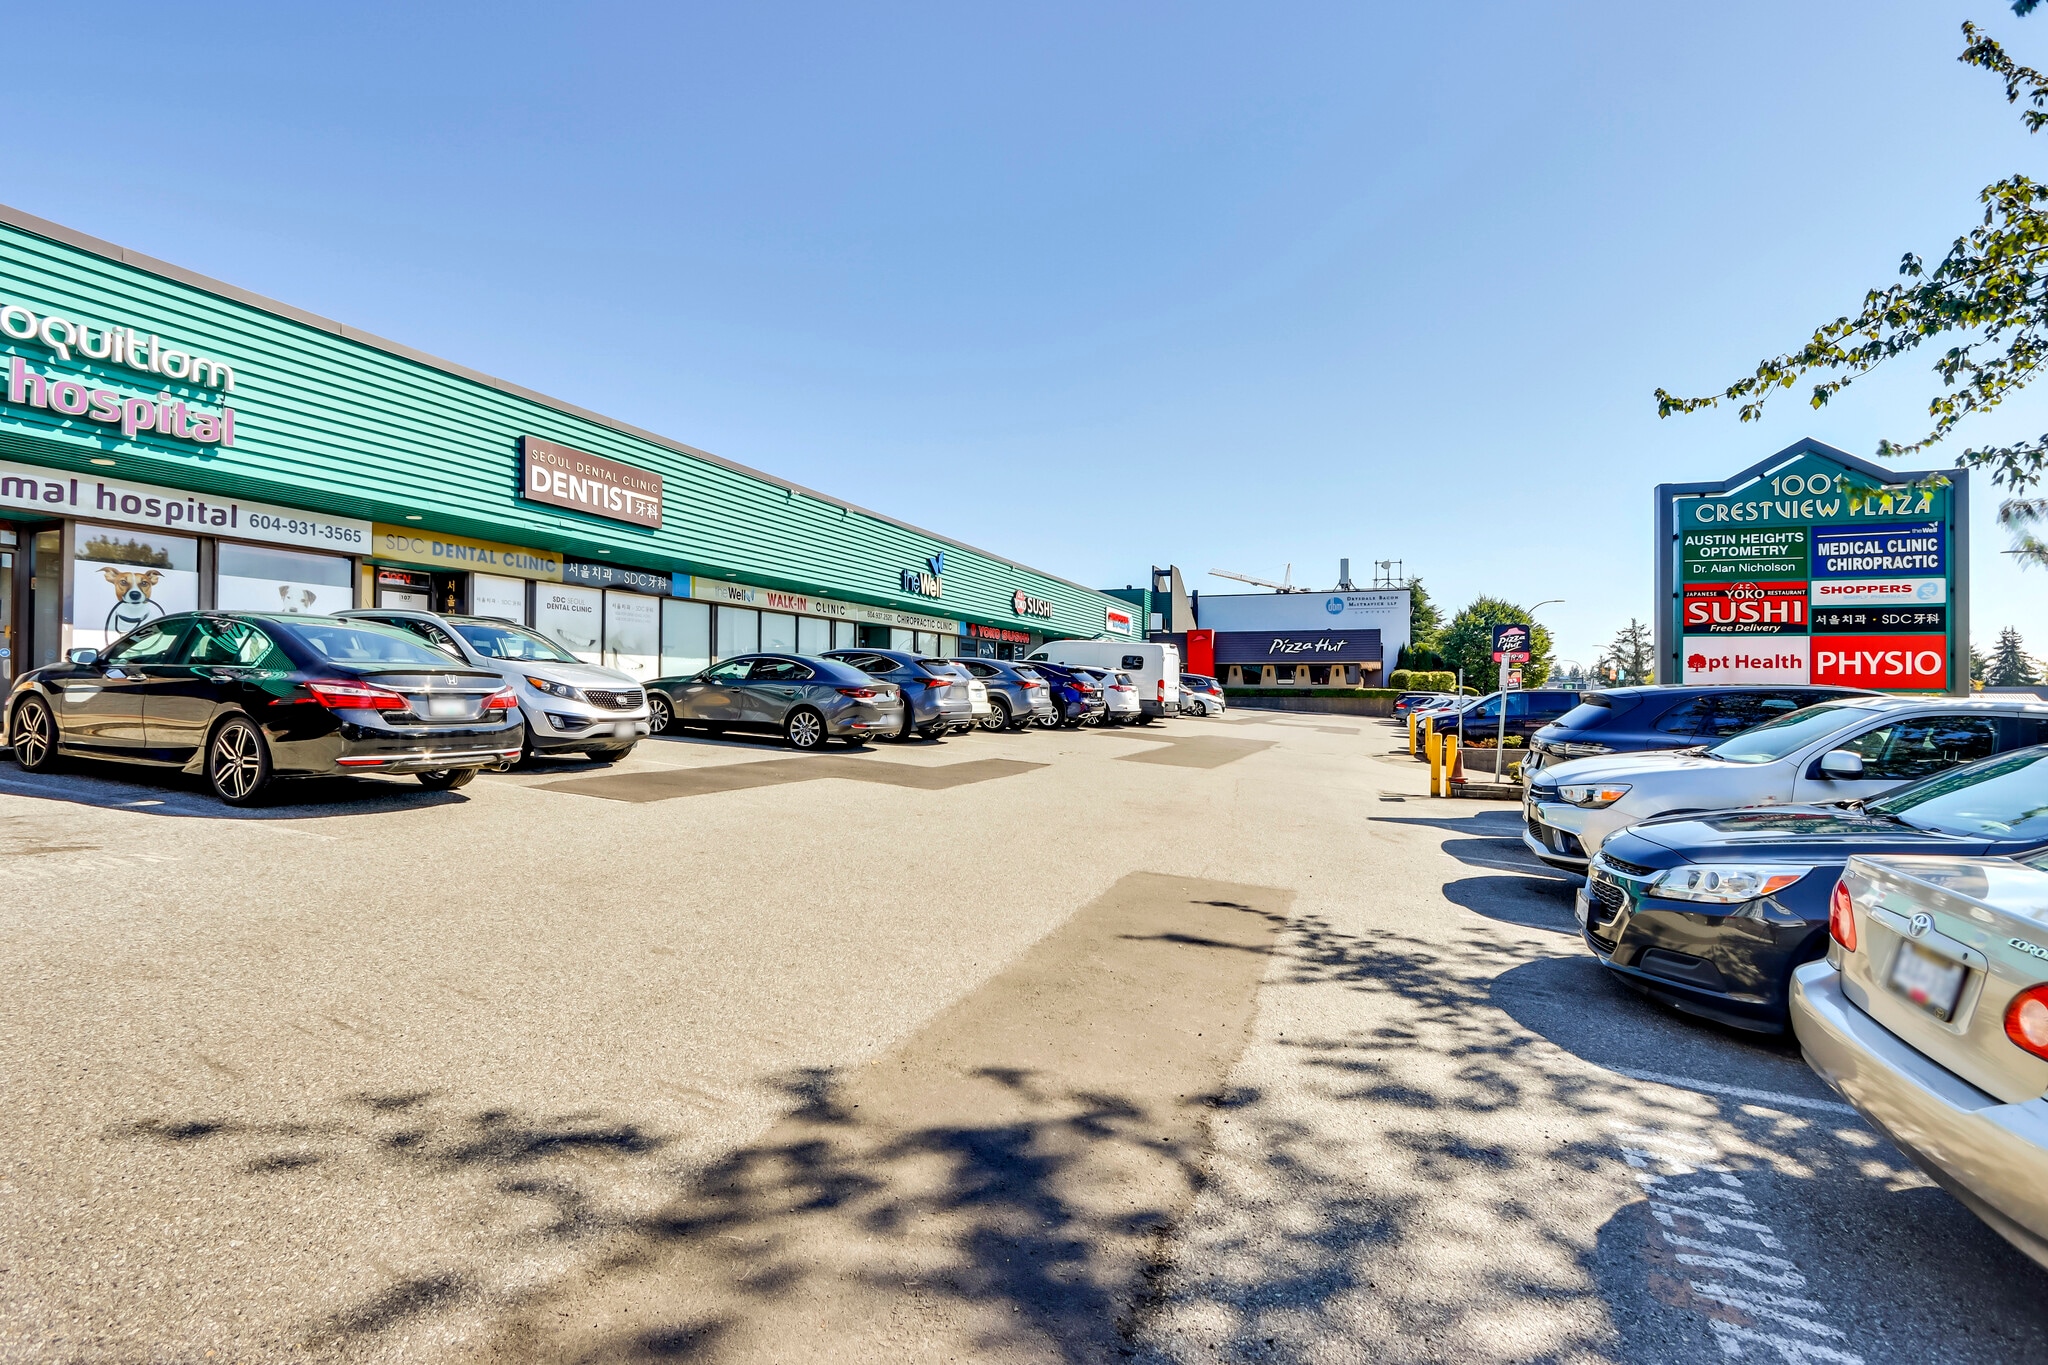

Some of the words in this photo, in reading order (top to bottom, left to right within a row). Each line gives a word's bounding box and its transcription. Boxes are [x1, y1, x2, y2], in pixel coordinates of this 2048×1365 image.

[8, 356, 235, 447] hospital
[532, 449, 571, 470] SEOUL
[576, 462, 618, 483] DENTAL
[622, 475, 658, 493] CLINIC
[531, 464, 658, 514] DENTIST
[1770, 473, 1842, 496] 1001
[1, 476, 79, 507] mal
[96, 482, 238, 529] hospital
[249, 513, 362, 544] 604-931-3565
[635, 500, 658, 520] 牙科
[1695, 498, 1840, 523] CRESTVIEW
[1850, 494, 1931, 517] PLAZA
[1685, 534, 1736, 546] AUSTIN
[1740, 532, 1804, 544] HEIGHTS
[1818, 541, 1883, 556] MEDICAL
[1887, 538, 1938, 553] CLINIC
[386, 533, 425, 554] SDC
[432, 541, 497, 564] DENTAL
[503, 552, 556, 573] CLINIC
[1700, 545, 1788, 557] OPTOMETRY
[1693, 564, 1707, 573] Dr.
[1711, 563, 1735, 573] Alan
[1739, 563, 1795, 572] Nicholson
[1827, 554, 1938, 571] CHIROPRACTIC
[569, 562, 612, 581] 서울치과
[1725, 589, 1765, 599] YOKO
[1820, 584, 1912, 594] SHOPPERS
[546, 603, 570, 611] DENTAL
[571, 605, 592, 613] CLINIC
[552, 596, 566, 604] SDC
[767, 592, 807, 611] WALK-IN
[816, 602, 845, 615] CLINIC
[1027, 597, 1053, 618] SUSHI
[1688, 601, 1802, 624] SUSHI
[1815, 614, 1867, 625] 서울치과
[897, 614, 935, 628] CHIROPRACTIC
[937, 621, 952, 630] CLINIC
[1710, 624, 1733, 632] Free
[1735, 623, 1781, 634] Delivery
[978, 626, 1000, 640] YOKO
[1002, 629, 1029, 643] SUSHI
[1497, 635, 1526, 648] Pizza
[1269, 638, 1313, 655] Pizza
[1315, 638, 1349, 653] Hut
[1502, 641, 1522, 651] Hut
[1708, 655, 1729, 672] pt
[1735, 653, 1802, 669] Health
[1817, 651, 1942, 675] PHYSIO
